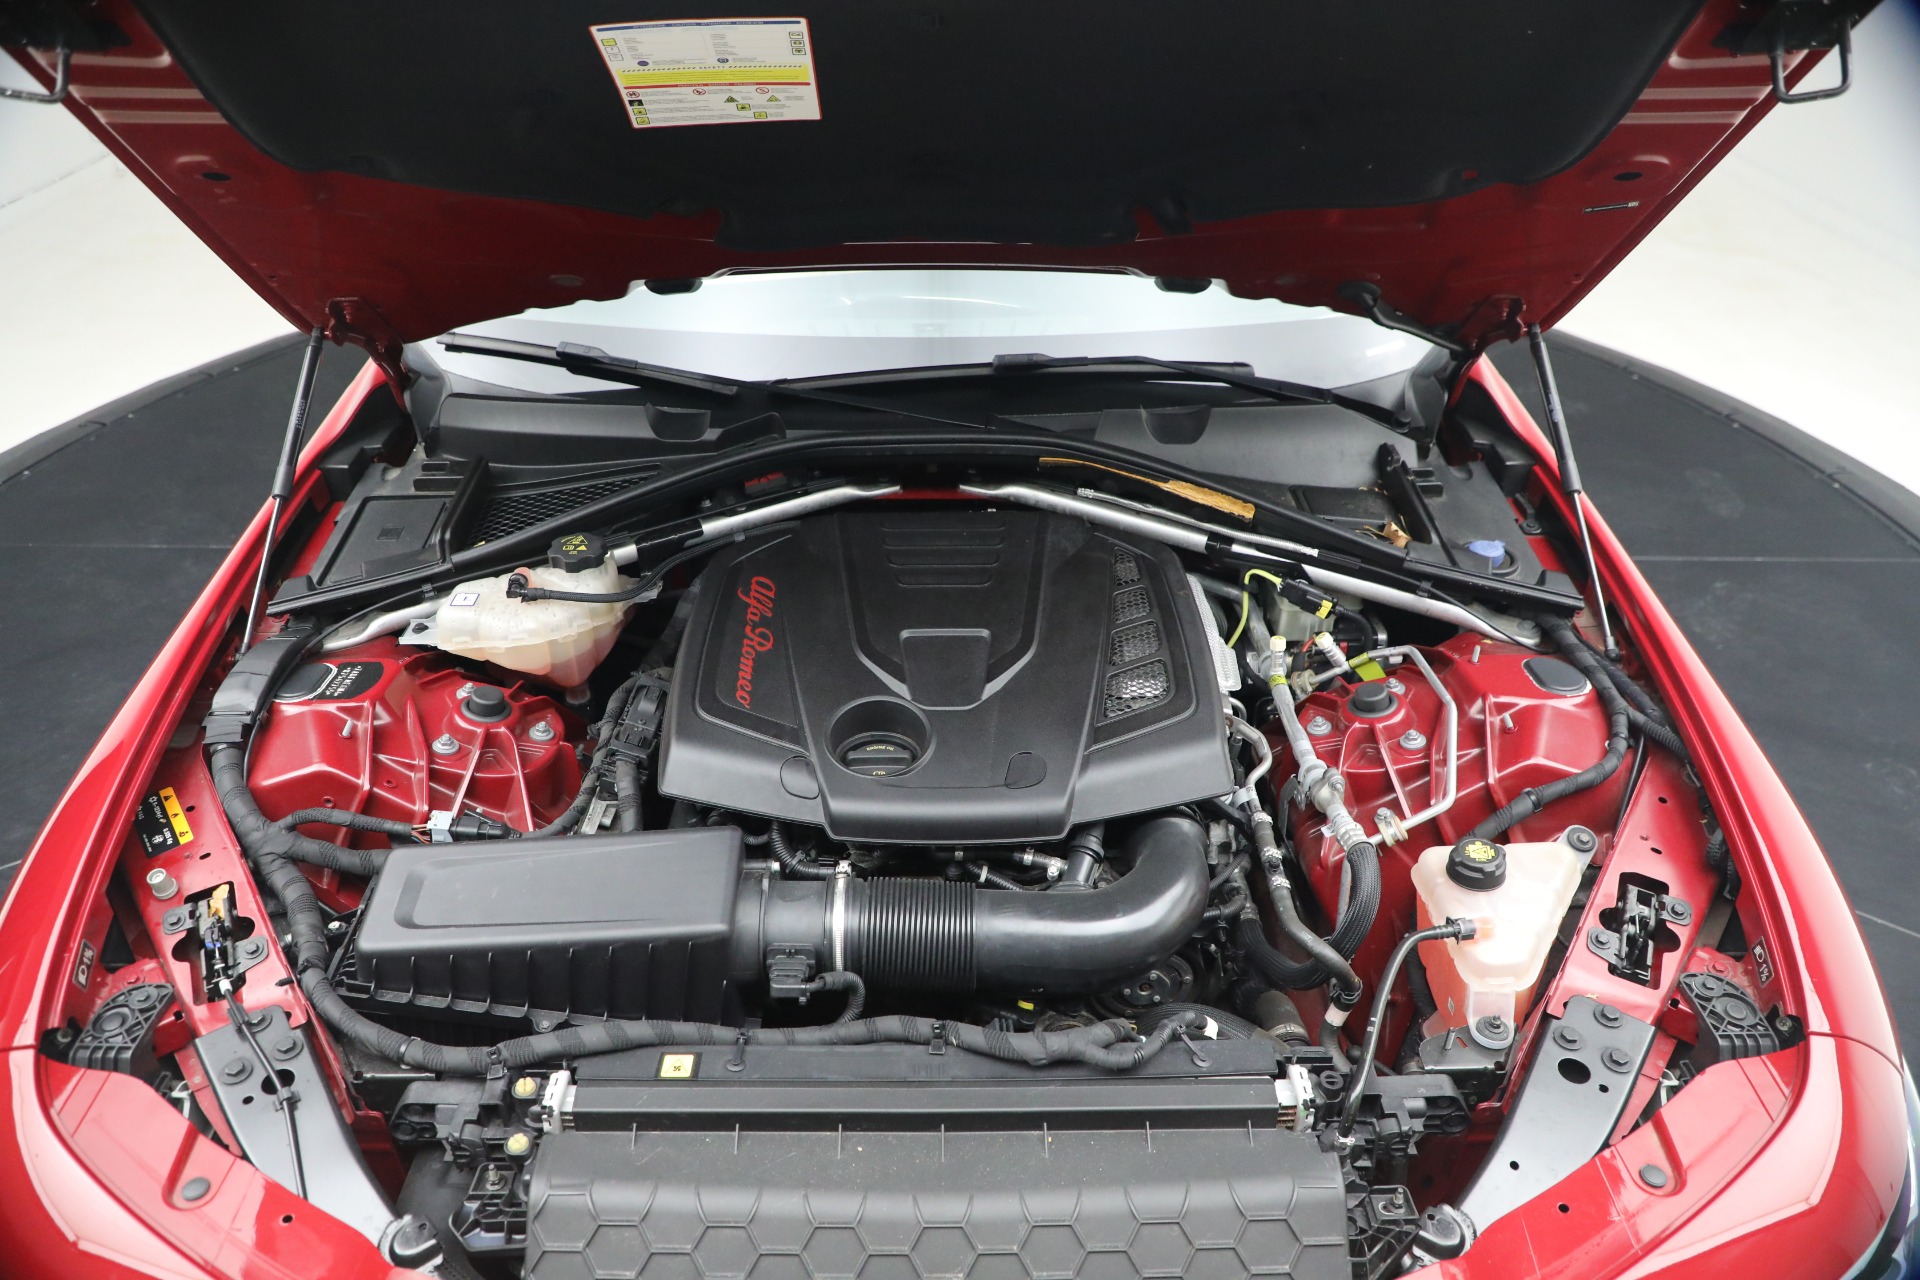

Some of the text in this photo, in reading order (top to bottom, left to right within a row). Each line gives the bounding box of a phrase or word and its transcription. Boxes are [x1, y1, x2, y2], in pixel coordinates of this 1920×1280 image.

[735, 575, 776, 709] Alfa Romeo
[1759, 963, 1769, 982] 1%
